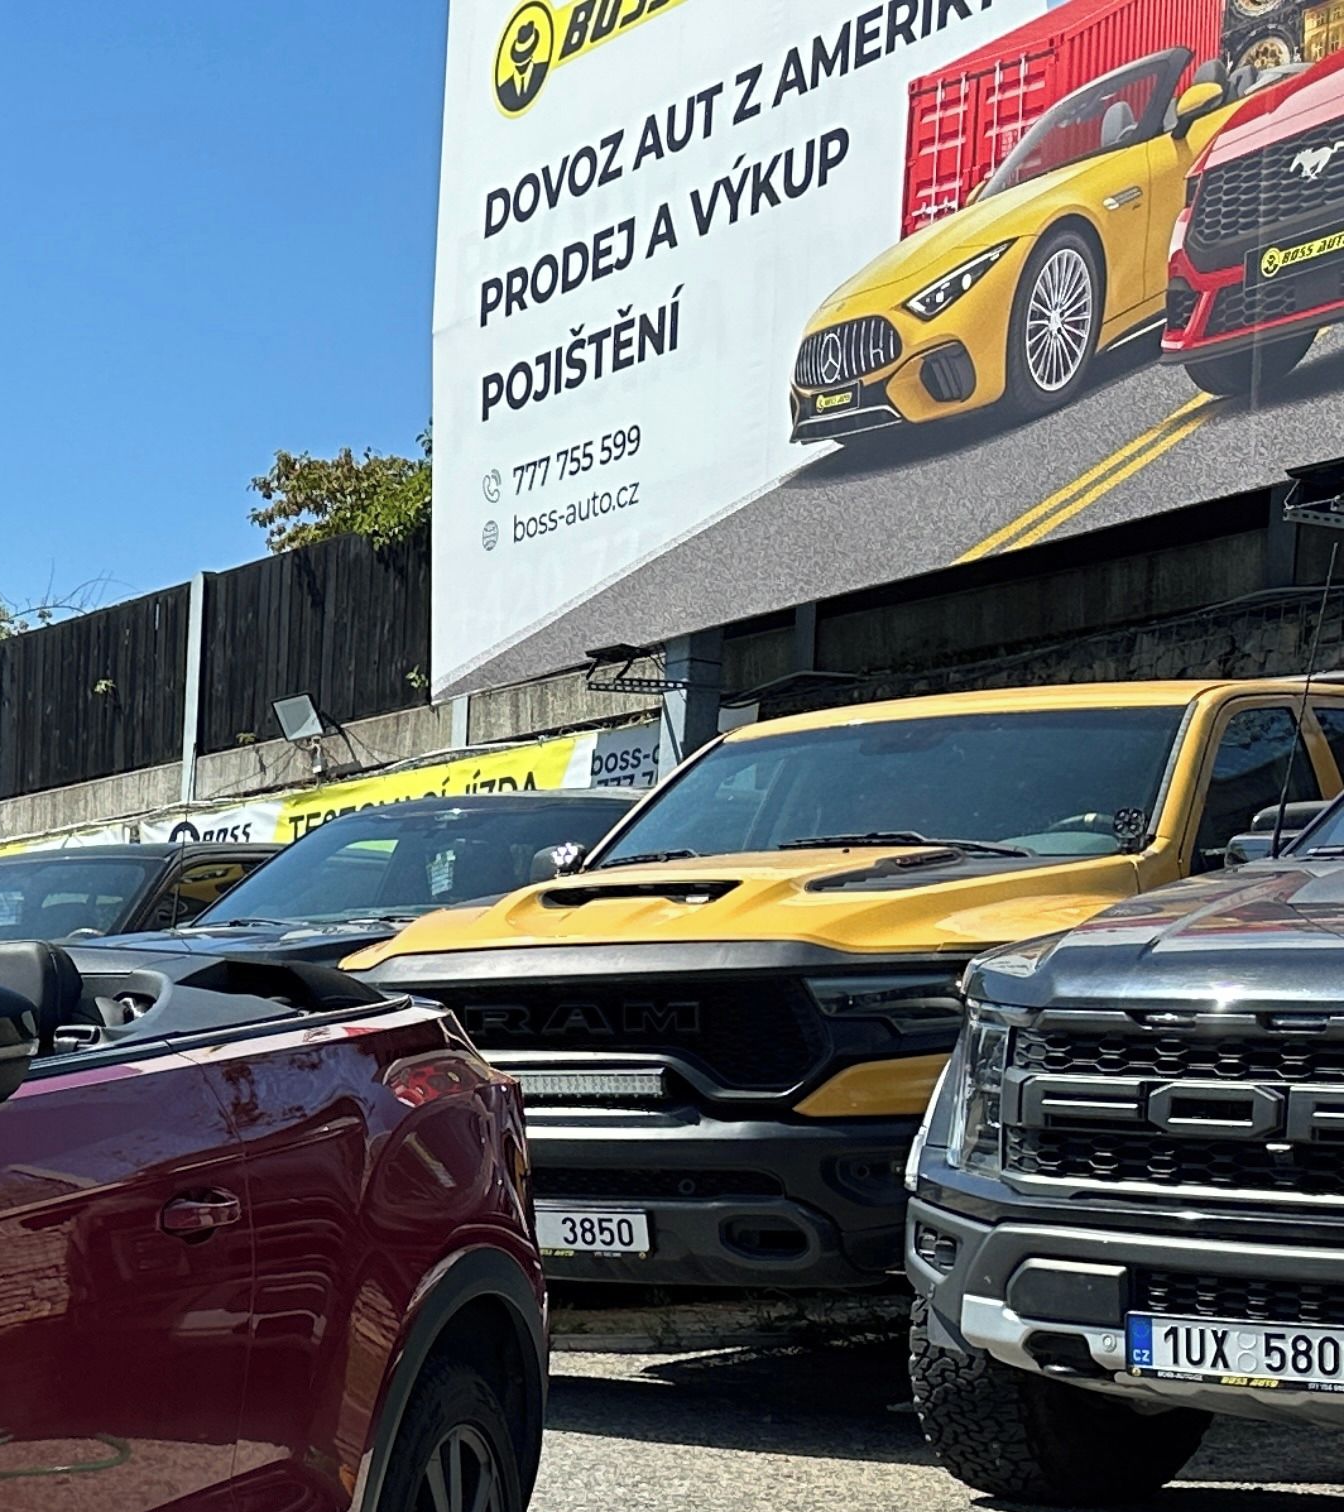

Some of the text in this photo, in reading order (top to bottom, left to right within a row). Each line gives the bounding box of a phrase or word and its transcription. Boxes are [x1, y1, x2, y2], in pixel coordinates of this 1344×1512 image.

[558, 0, 670, 61] BO
[484, 0, 993, 238] DOVOZ AUT Z AMERIK
[479, 127, 850, 327] PRODEJ A VÝKUP
[1317, 237, 1344, 253] AUT
[481, 283, 685, 422] POJIŠTĚNÍ
[513, 425, 641, 495] 777 755 599
[513, 481, 640, 543] boss-auto.cz
[464, 1001, 701, 1036] RAM
[561, 1217, 634, 1247] 3850
[1133, 1349, 1150, 1362] CZ
[1164, 1325, 1340, 1375] 1UX 580
